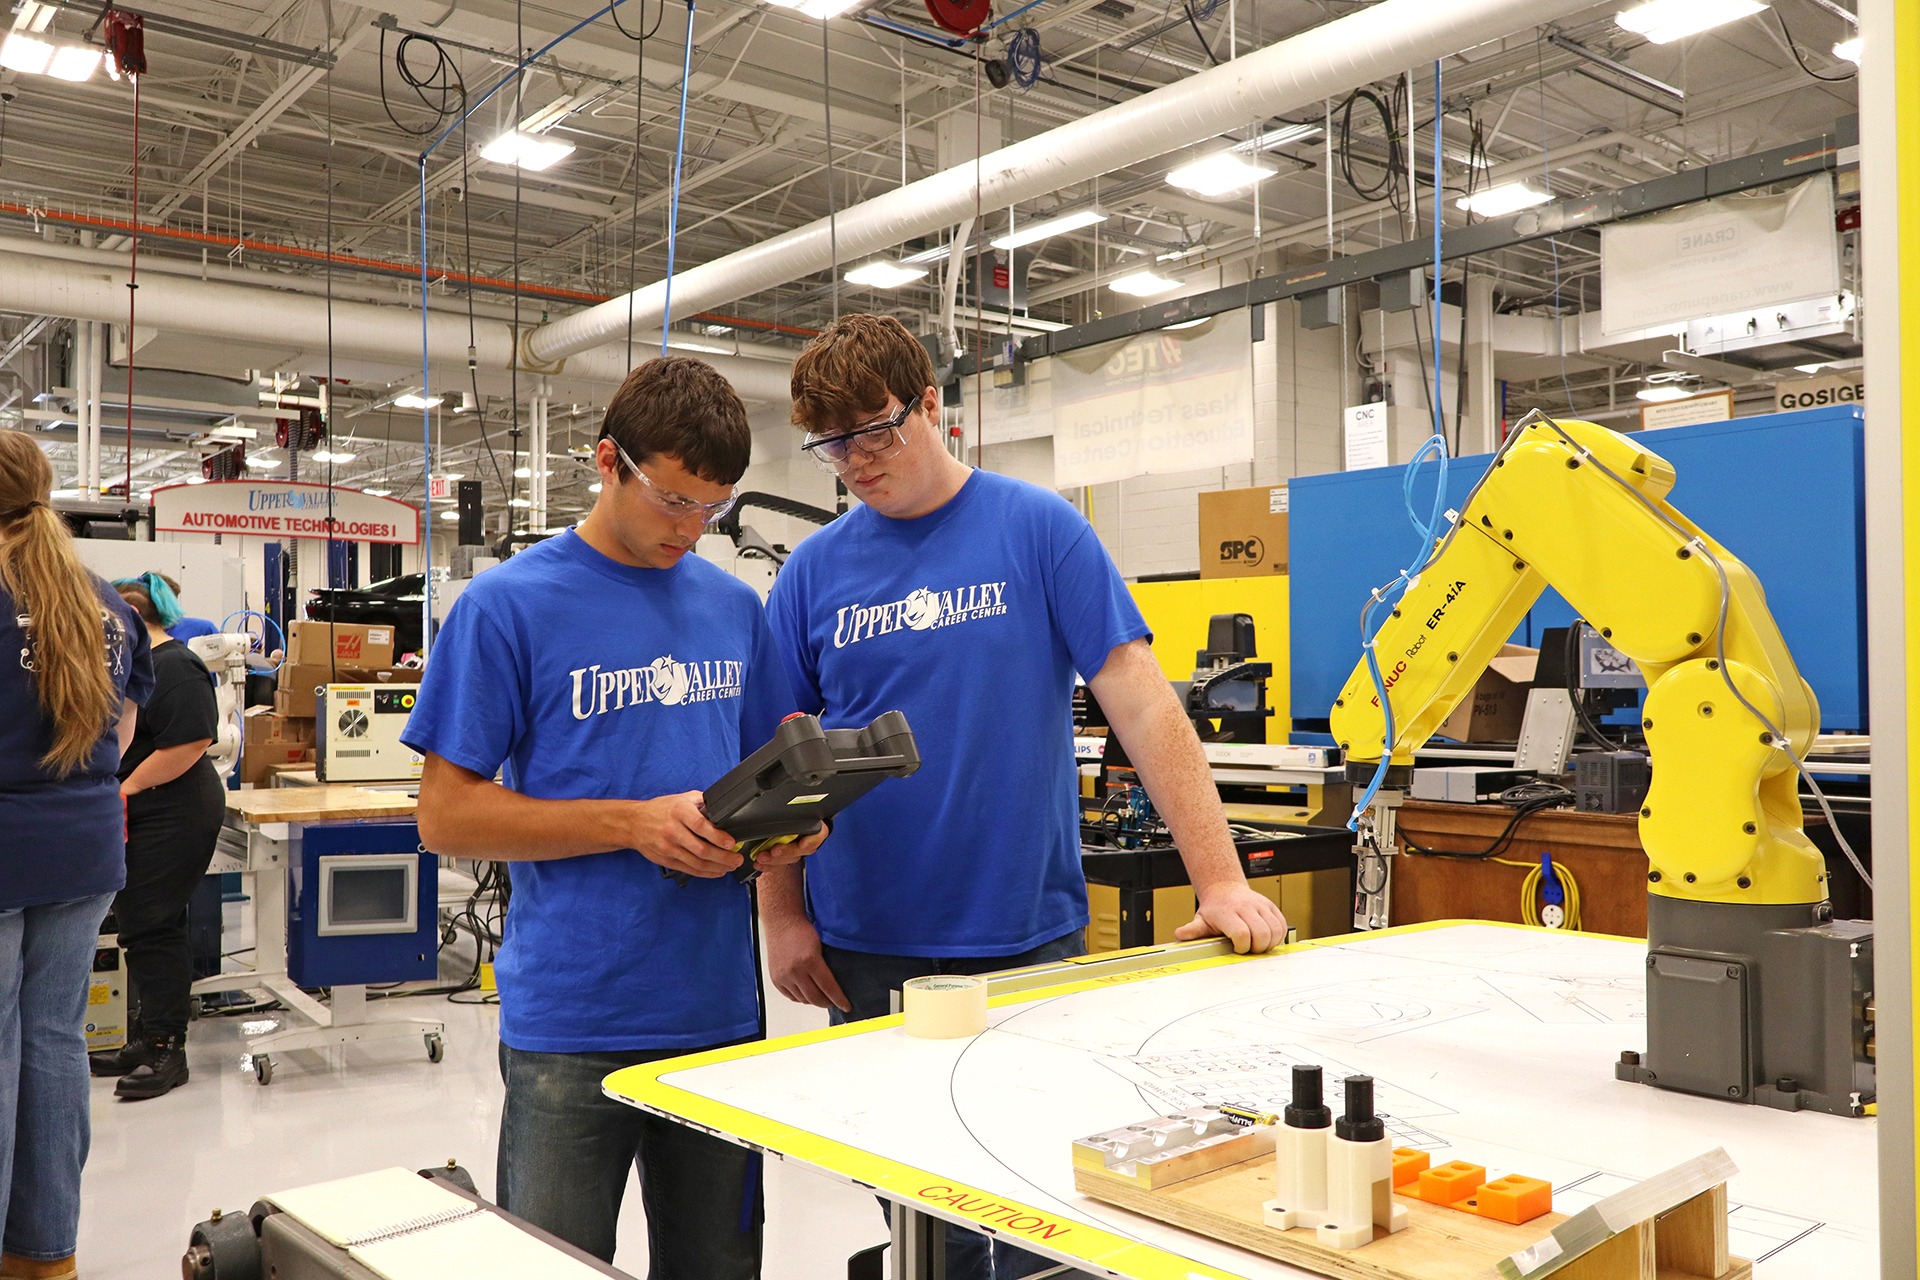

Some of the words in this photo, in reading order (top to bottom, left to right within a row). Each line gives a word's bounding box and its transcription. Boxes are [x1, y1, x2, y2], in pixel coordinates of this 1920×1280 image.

[1356, 409, 1374, 420] CNC
[249, 490, 294, 511] UPPER
[431, 480, 444, 496] EXIT
[182, 512, 280, 531] AUTOMOTIVE
[286, 517, 389, 537] TECHNOLOGIES
[392, 525, 396, 537] I
[1220, 540, 1257, 560] SPC
[833, 599, 926, 649] UPPER
[933, 582, 1007, 619] VALLEY
[931, 612, 967, 630] CAREER
[971, 605, 1007, 620] CENTER
[1405, 634, 1427, 659] Robot
[569, 665, 669, 721] UPPER
[677, 660, 743, 694] VALLEY
[1370, 660, 1407, 708] FNUC
[917, 1186, 1072, 1240] CAUTION
